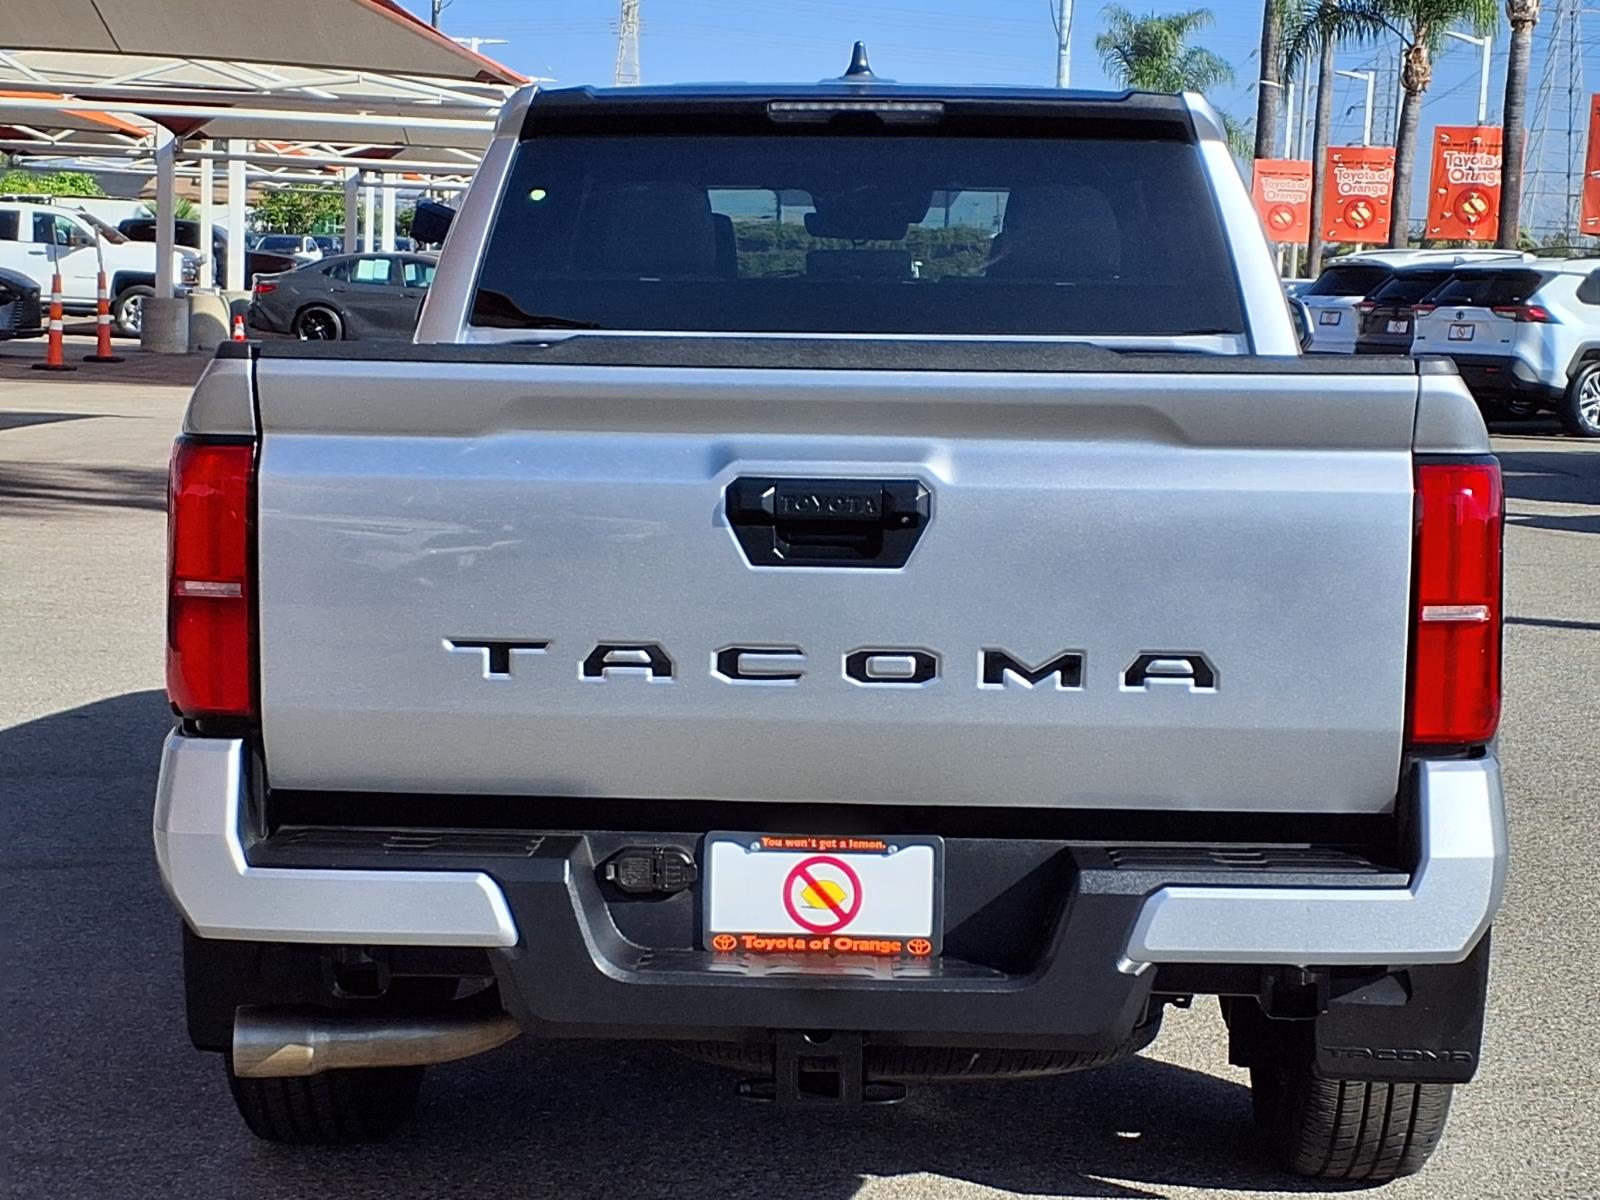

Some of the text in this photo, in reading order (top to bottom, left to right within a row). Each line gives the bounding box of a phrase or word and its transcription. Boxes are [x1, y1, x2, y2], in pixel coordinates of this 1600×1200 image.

[1445, 152, 1493, 168] Toyota
[1336, 168, 1392, 182] Toyota of
[1449, 167, 1502, 185] Orang
[1262, 178, 1297, 190] Toyota
[1340, 181, 1387, 195] Orange
[1266, 189, 1305, 202] Orange
[780, 495, 877, 514] TOYOTA
[442, 637, 1220, 693] TACOMA
[762, 837, 887, 851] You won't get a lemon.
[742, 935, 902, 951] Toyota of Orange
[1321, 1046, 1473, 1063] TACOMA
